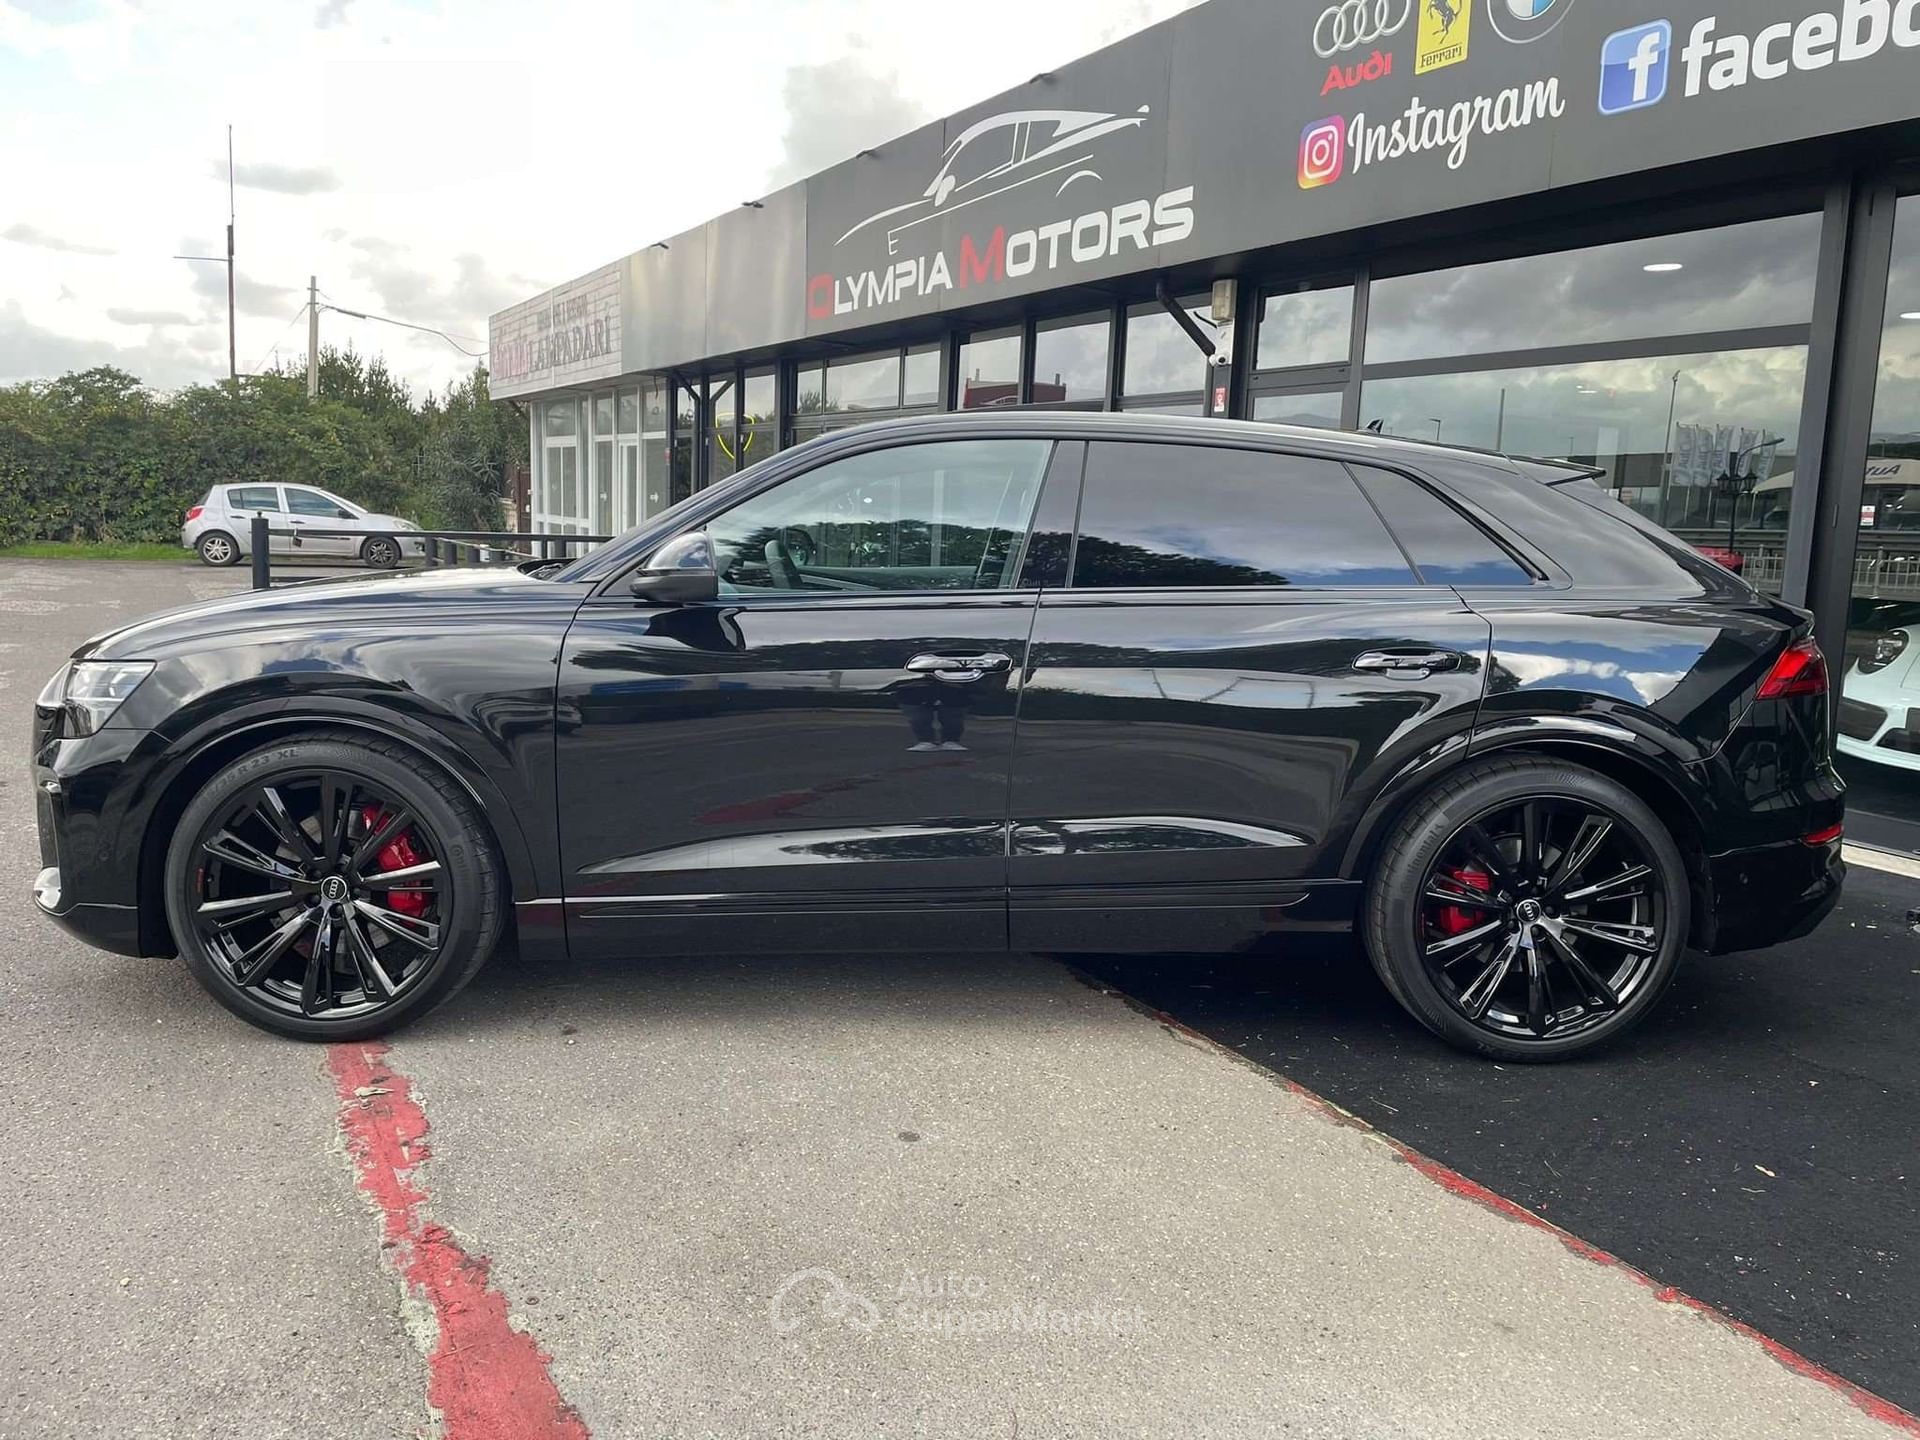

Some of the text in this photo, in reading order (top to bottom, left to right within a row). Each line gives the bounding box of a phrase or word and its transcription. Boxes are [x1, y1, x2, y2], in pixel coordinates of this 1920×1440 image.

[1420, 43, 1463, 68] Ferrari
[1347, 77, 1565, 174] Instagram
[807, 185, 1194, 320] OLYMPIA MOTORS
